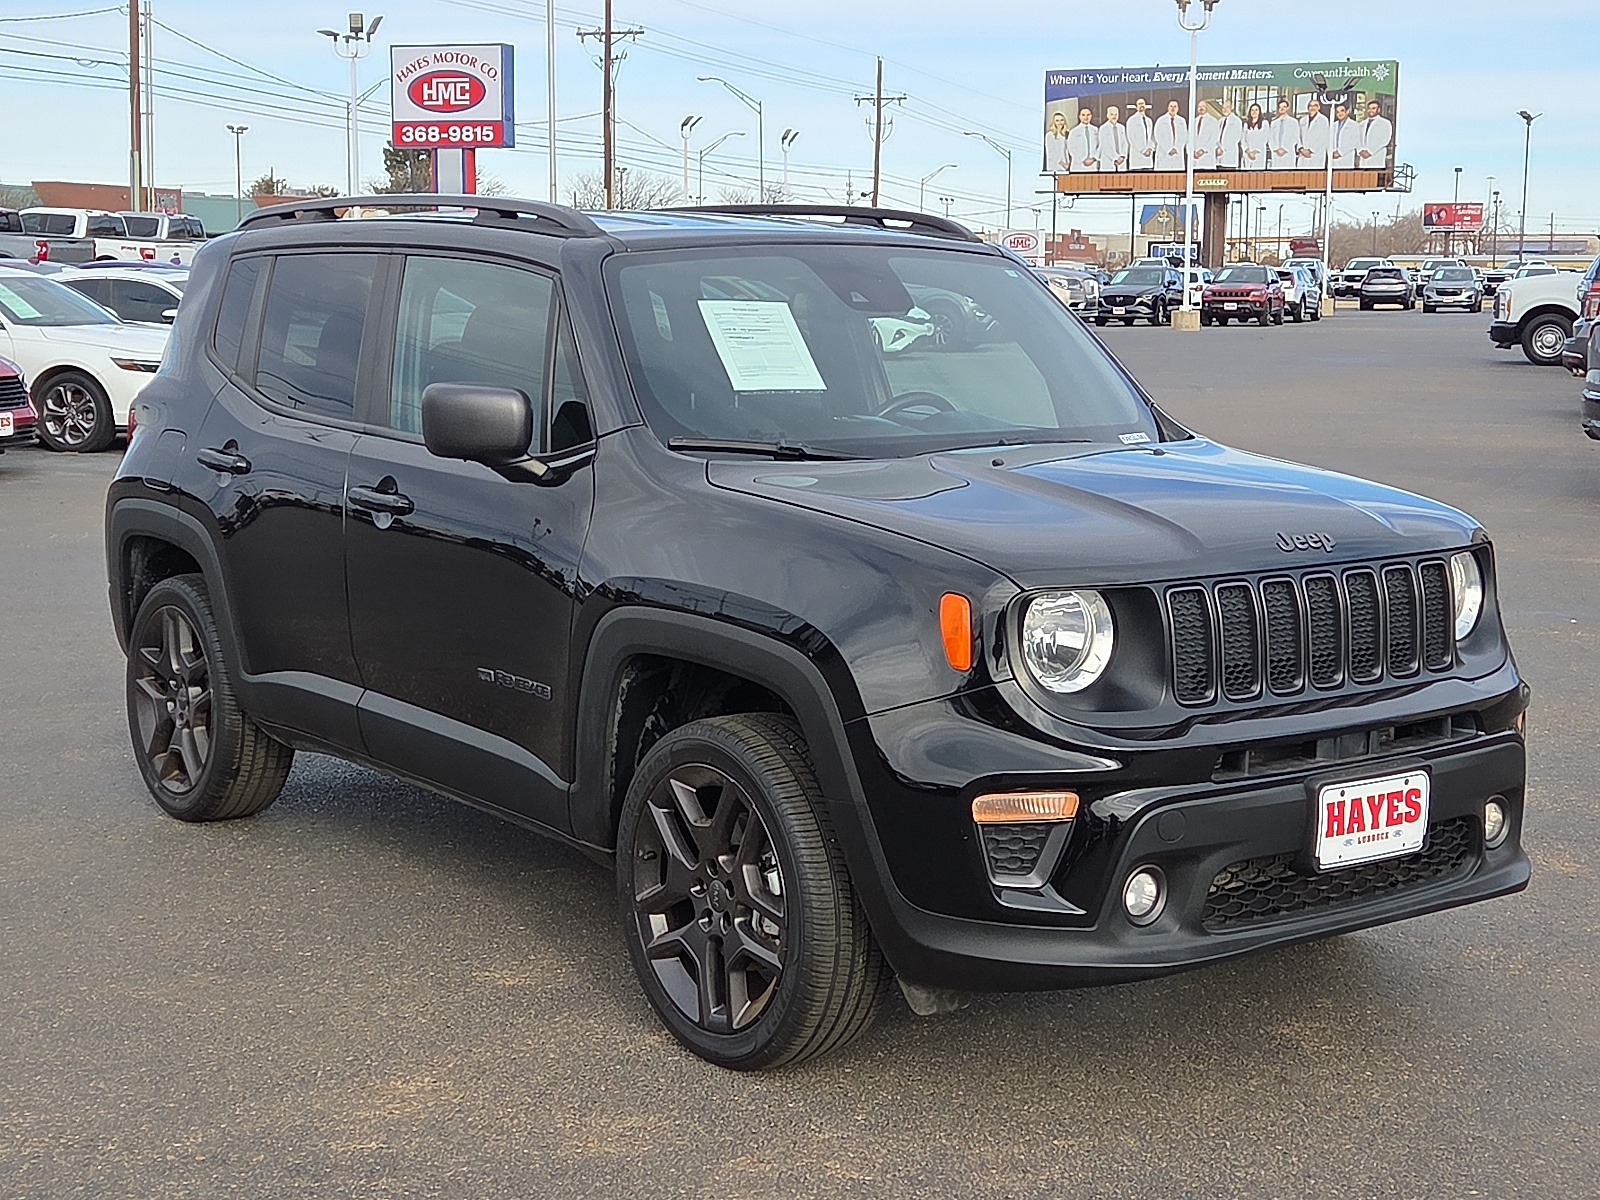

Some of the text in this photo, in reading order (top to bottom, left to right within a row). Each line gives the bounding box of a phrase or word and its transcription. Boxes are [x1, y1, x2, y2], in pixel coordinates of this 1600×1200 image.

[396, 52, 498, 83] HAYES MOTOR CO.
[1049, 74, 1078, 85] When
[1080, 73, 1094, 84] It's
[1096, 73, 1119, 84] Your
[1121, 72, 1152, 83] Heart,
[1152, 71, 1184, 84] Every
[1230, 69, 1275, 80] Matters.
[423, 77, 470, 105] HMC
[401, 125, 494, 142] 368-9815
[1275, 532, 1337, 554] Jeep
[1325, 787, 1422, 839] HAYES
